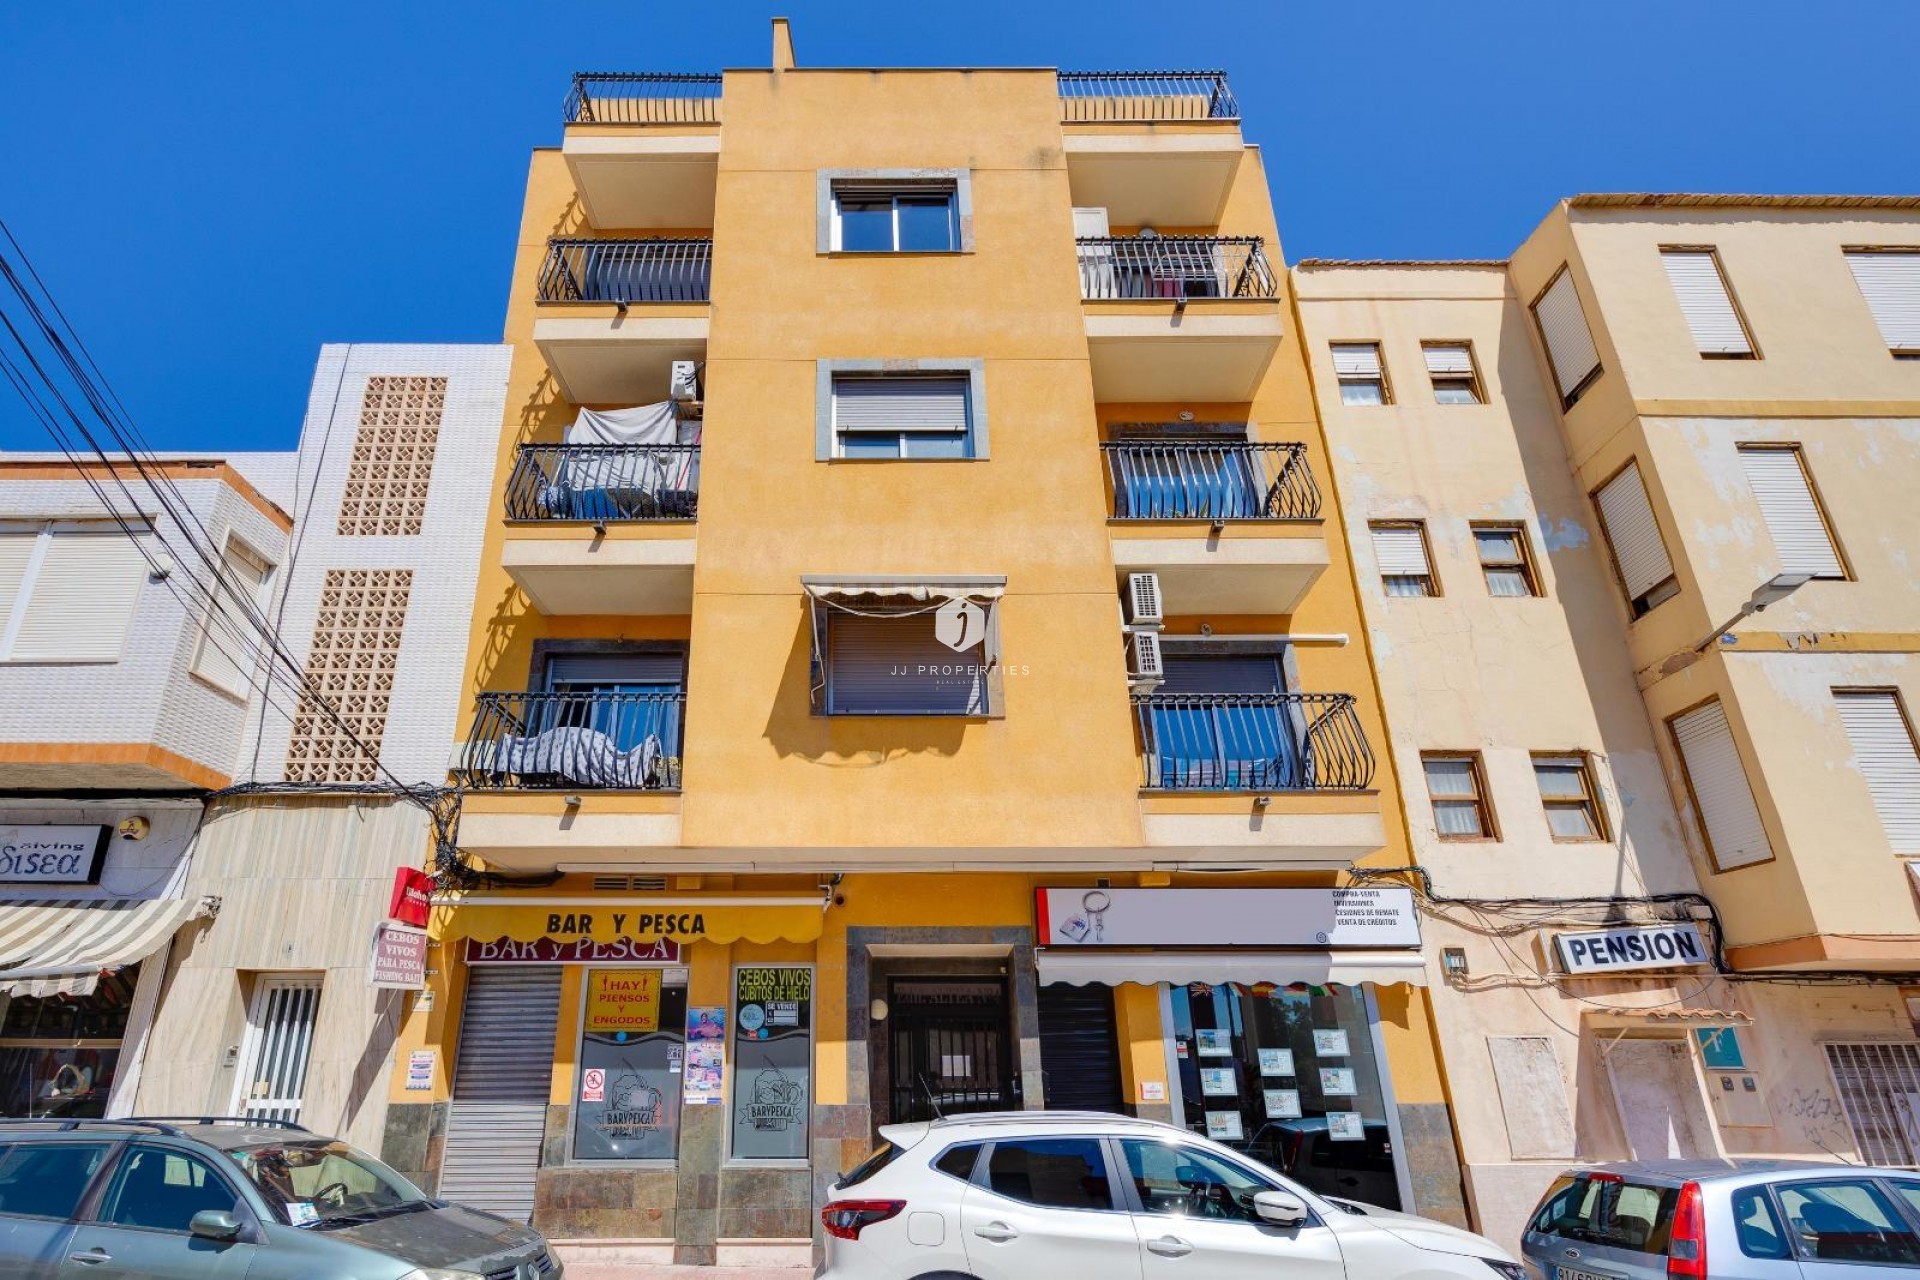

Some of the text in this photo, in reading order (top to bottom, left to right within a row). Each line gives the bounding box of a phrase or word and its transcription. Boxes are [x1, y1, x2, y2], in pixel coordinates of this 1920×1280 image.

[1366, 908, 1374, 916] DE
[547, 913, 706, 934] BAR Y PESCA
[1337, 918, 1357, 926] VENTA
[1358, 918, 1366, 926] DE
[385, 931, 420, 945] CEBOS
[385, 945, 417, 958] VIVOS
[479, 938, 540, 960] BAR
[574, 936, 670, 960] PESCA
[1568, 931, 1699, 967] PENSION
[377, 957, 421, 970] PARA PESCA
[375, 970, 421, 983] FISHING BAIT
[739, 968, 811, 986] CEBOS VIVOS
[599, 994, 650, 1002] PIENSOS
[739, 985, 809, 1001] CUBITOS DE HIELO
[594, 1016, 650, 1024] ENGODOS
[751, 1105, 792, 1118] BARYPESCA
